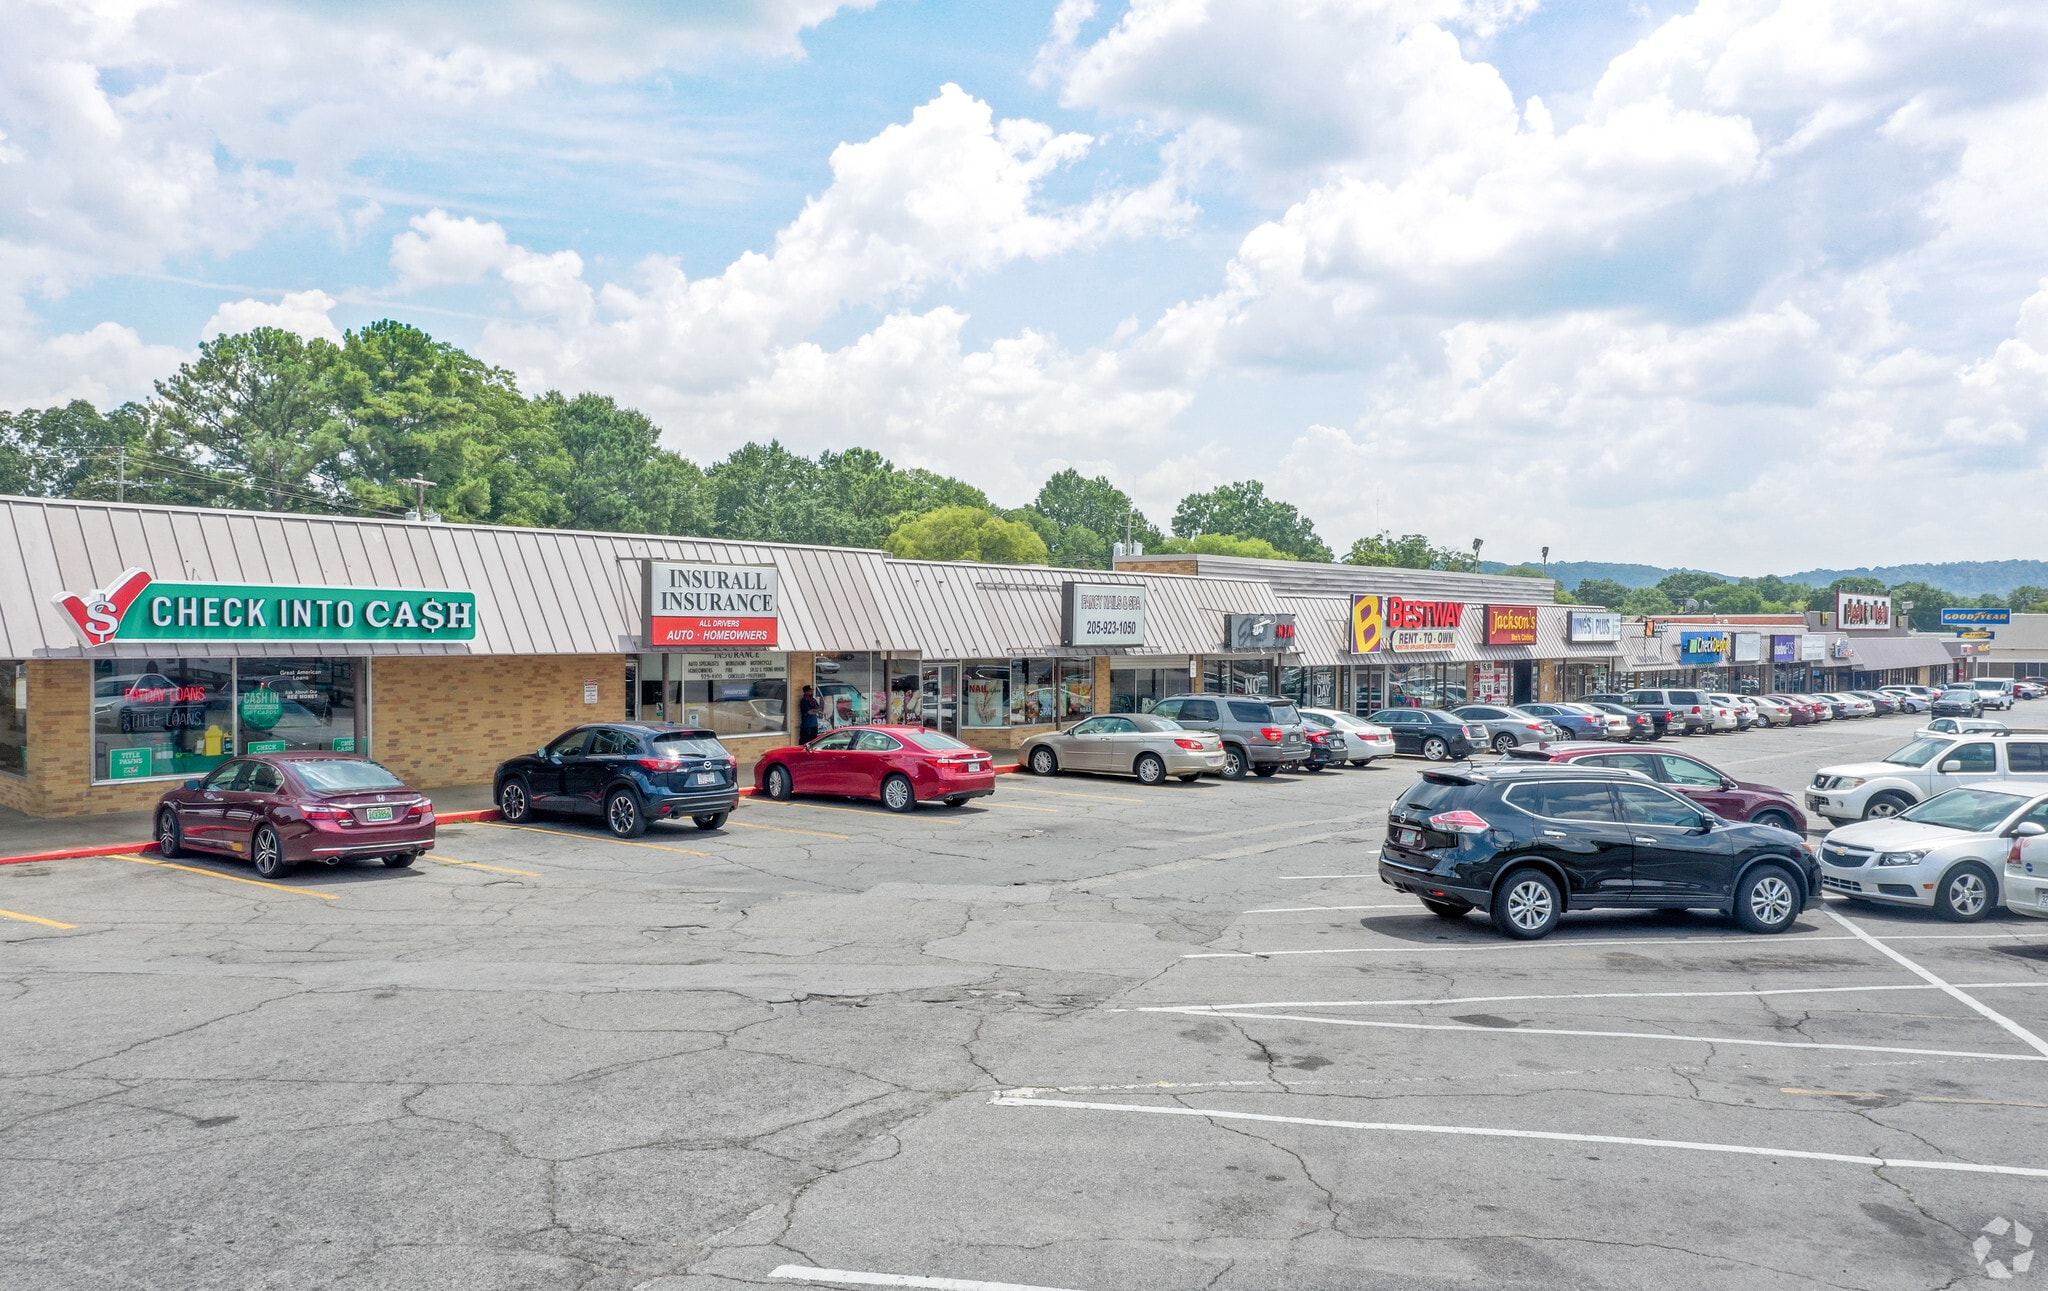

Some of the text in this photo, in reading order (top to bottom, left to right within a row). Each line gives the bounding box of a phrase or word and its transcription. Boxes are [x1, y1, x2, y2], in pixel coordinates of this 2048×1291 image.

[670, 569, 768, 590] INSURALL
[660, 592, 772, 612] INSURANCE
[1082, 594, 1102, 610] FANCY
[1104, 595, 1122, 610] NAILS
[1128, 596, 1141, 610] SPA
[152, 596, 472, 634] CHECK INTO CA$H
[1388, 596, 1465, 628] BESTWAY
[1944, 612, 2008, 621] GOODYEAR
[1087, 620, 1136, 635] 205-923-1050
[1492, 609, 1536, 634] Jackson's
[667, 630, 768, 640] AUTO HOMEOWNERS
[1399, 632, 1454, 644] RENT TO OWN
[969, 684, 989, 693] NAIL
[1245, 677, 1260, 694] NO
[1317, 685, 1331, 698] DAY
[170, 686, 207, 702] LOANS
[244, 692, 279, 704] CASH IN
